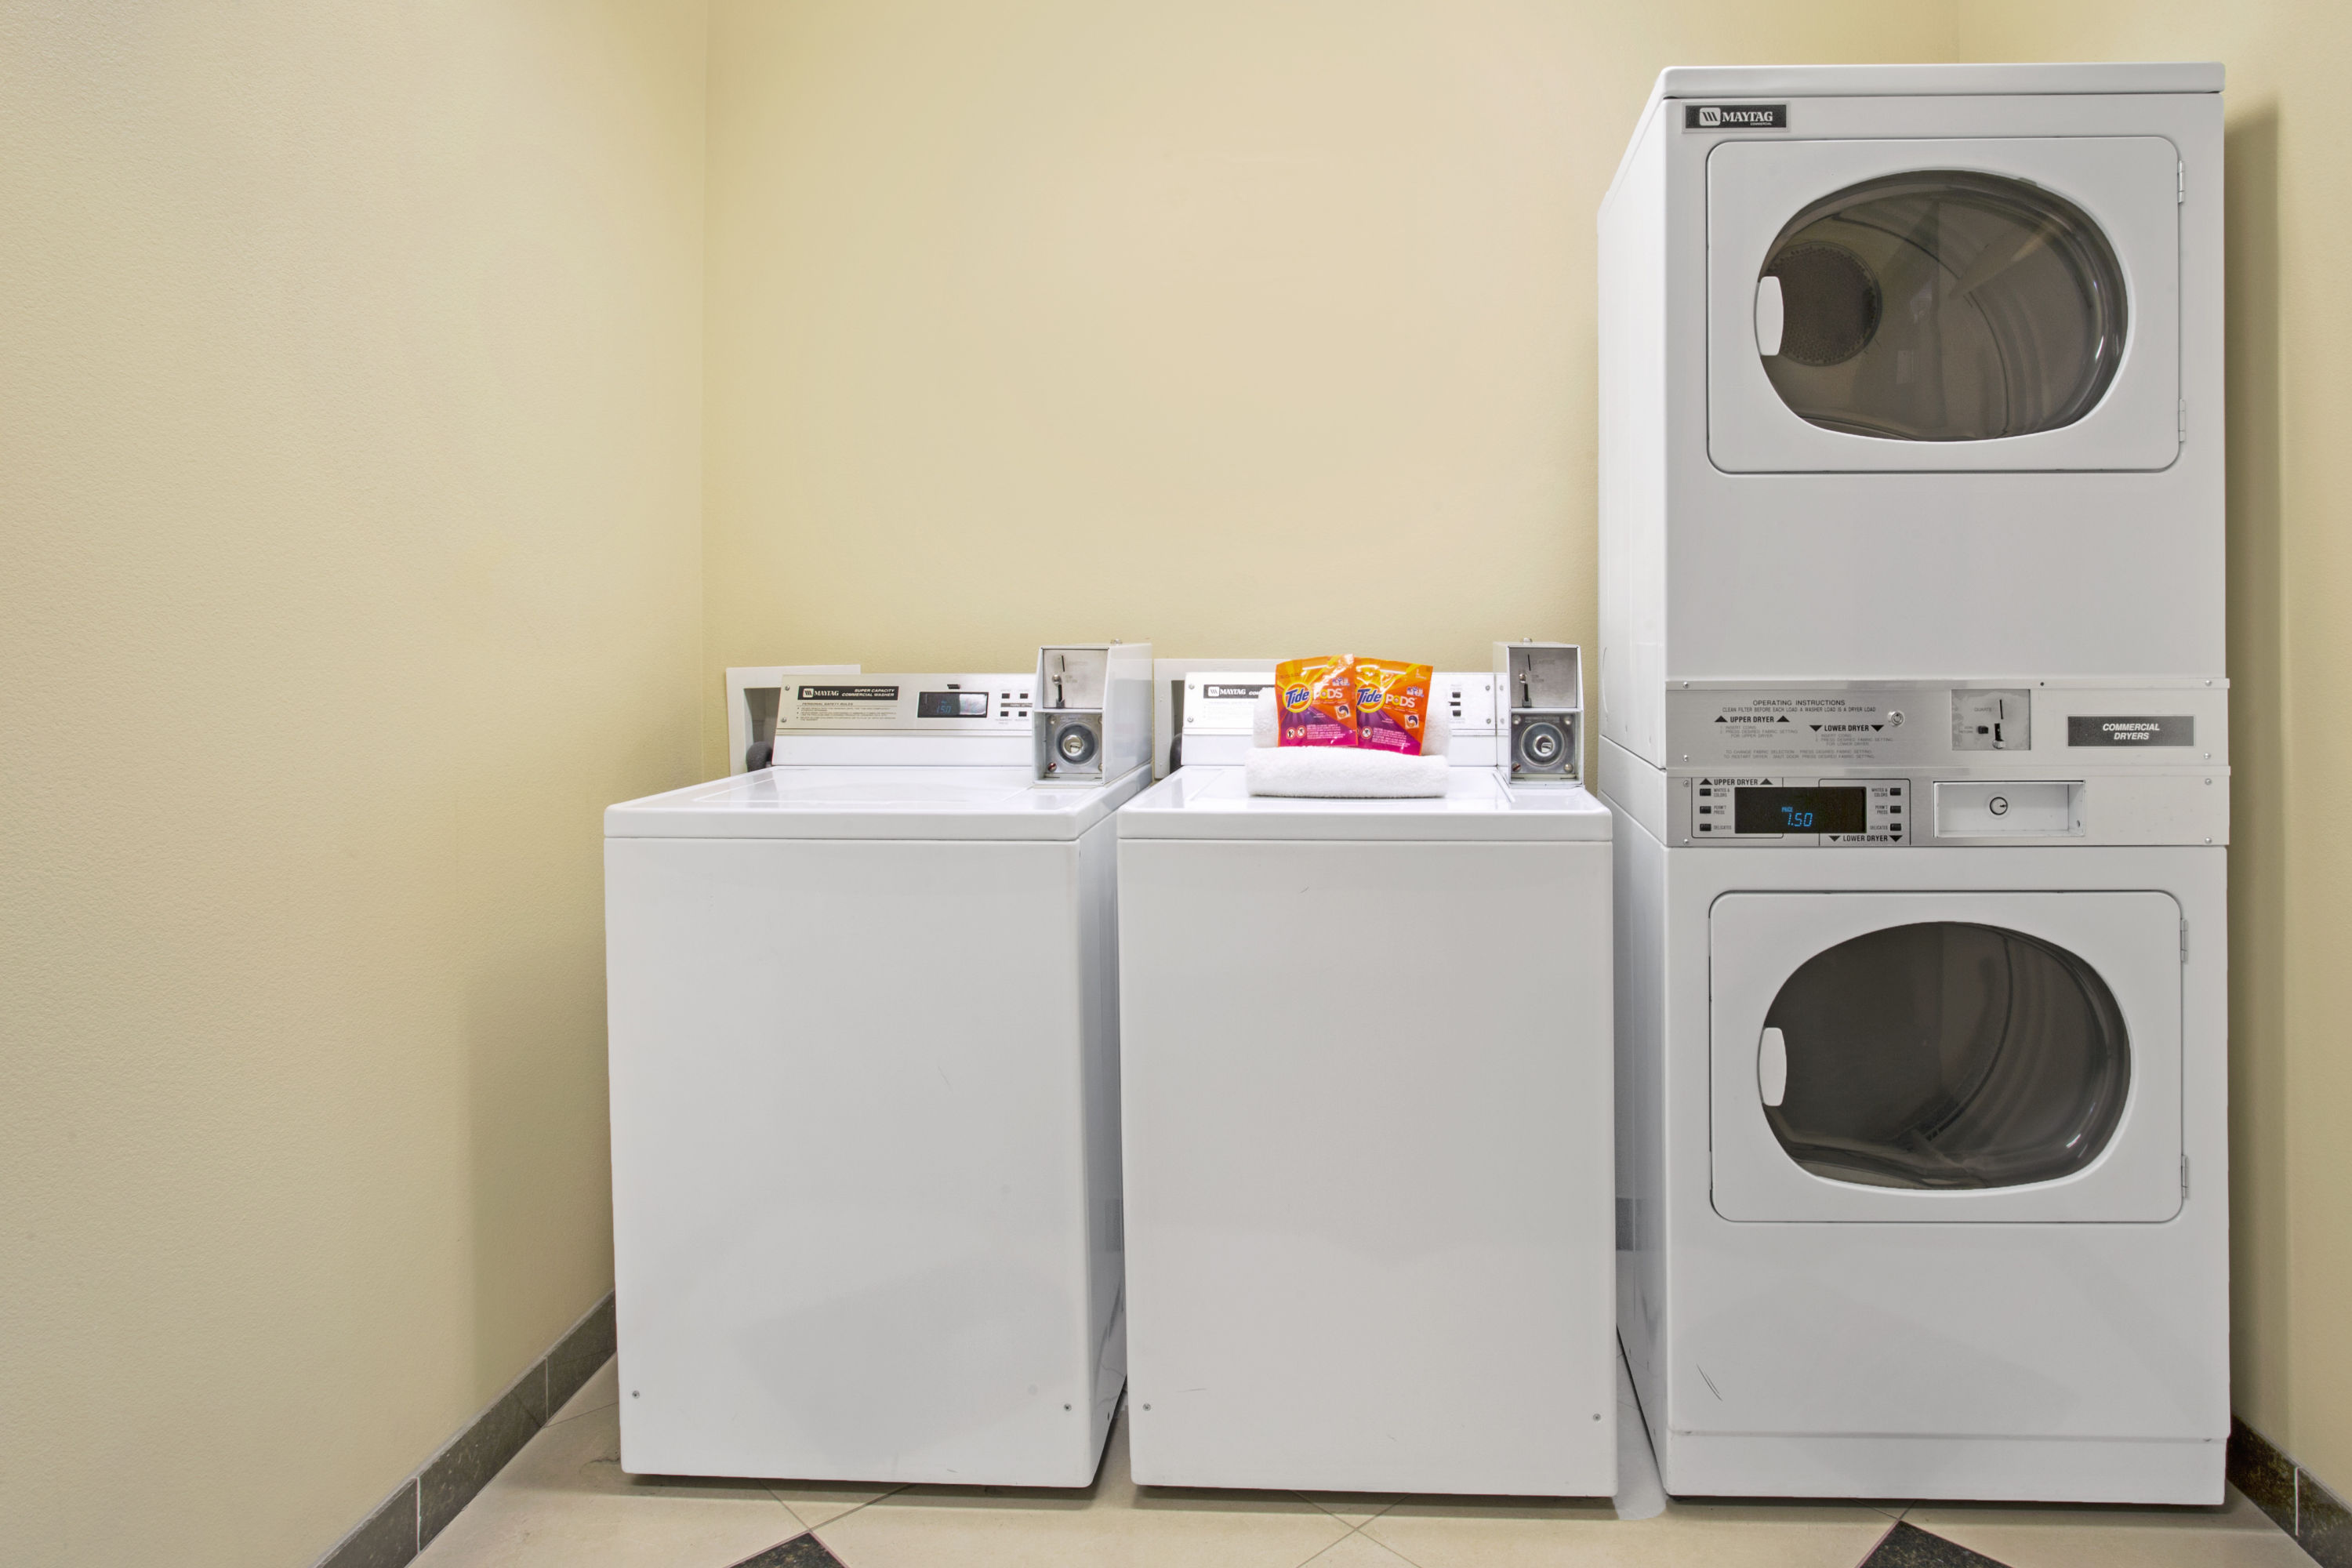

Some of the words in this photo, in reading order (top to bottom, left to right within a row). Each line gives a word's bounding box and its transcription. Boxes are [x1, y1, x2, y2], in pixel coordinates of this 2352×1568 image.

[1722, 111, 1773, 122] MAYTAG
[1286, 688, 1310, 708] Tide
[1356, 688, 1382, 706] Tide
[1385, 693, 1416, 708] PODS
[2103, 723, 2160, 731] COMMERCIAL
[1788, 812, 1813, 827] 1.50
